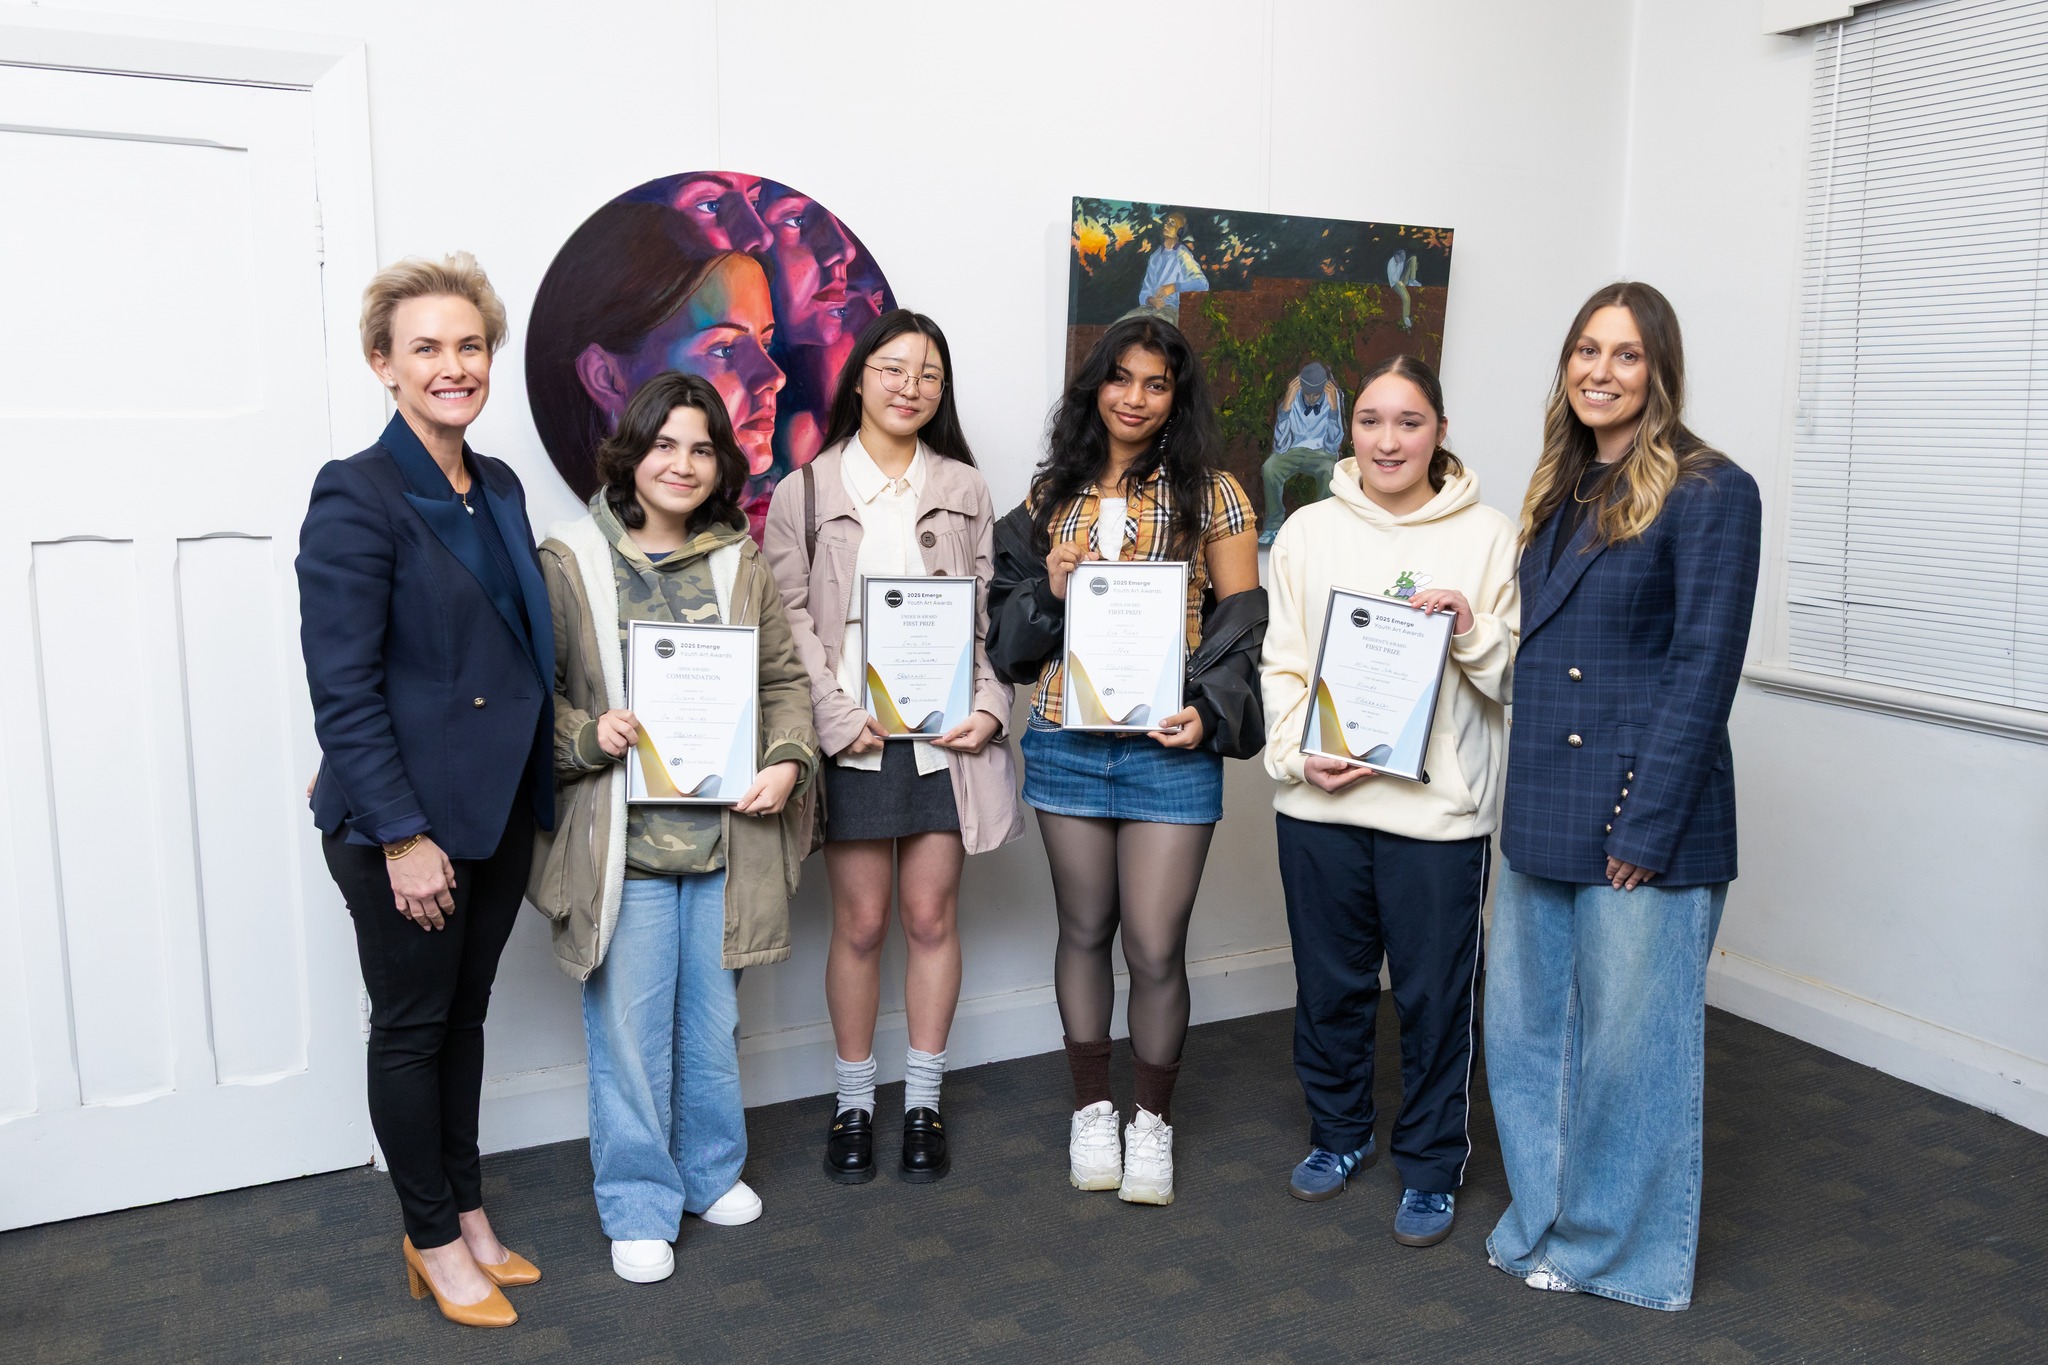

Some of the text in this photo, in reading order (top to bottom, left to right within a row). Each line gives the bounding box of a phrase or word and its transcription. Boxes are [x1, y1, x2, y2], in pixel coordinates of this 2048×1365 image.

[1391, 618, 1414, 627] Emerge
[1374, 623, 1391, 631] Youth
[1402, 629, 1424, 638] Awards
[1365, 643, 1401, 656] FIRST PRIZE
[666, 673, 721, 681] COMMENDATION
